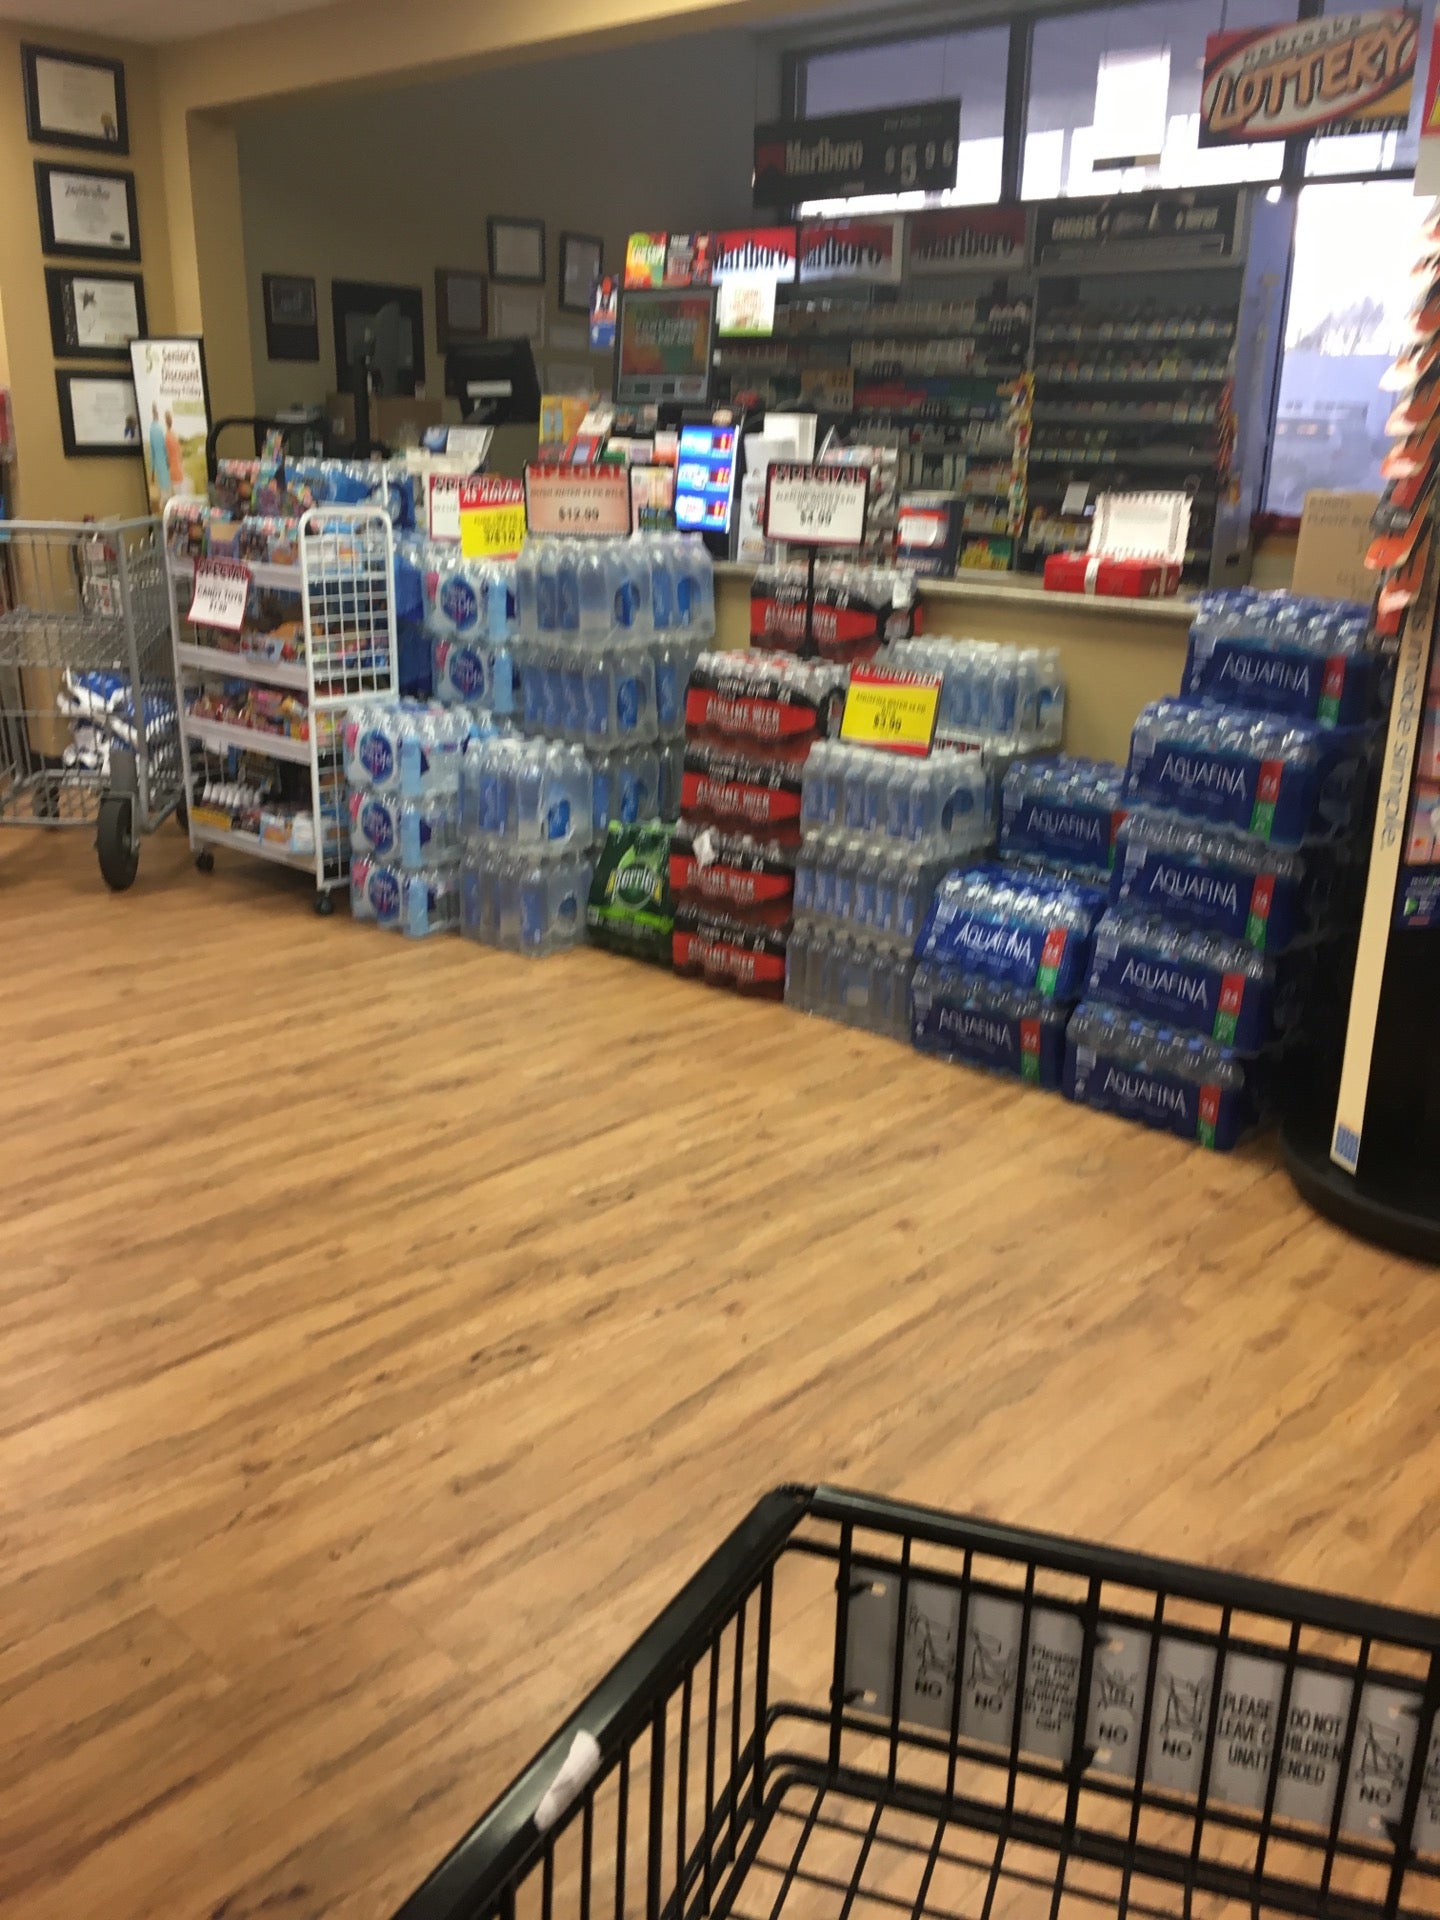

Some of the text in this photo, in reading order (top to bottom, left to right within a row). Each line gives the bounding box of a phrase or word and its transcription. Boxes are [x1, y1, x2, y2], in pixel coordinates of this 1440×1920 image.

[1208, 16, 1414, 133] LOTTERY
[775, 463, 860, 485] SPECIAL
[872, 664, 941, 688] ADVERTISED
[1219, 651, 1310, 697] AQUAFINA
[1159, 752, 1248, 800] AQUAFINA
[1026, 805, 1101, 845] AQUAFINA
[1149, 864, 1238, 915] AQUAFINA
[953, 918, 1032, 965] AQUAFINA
[1120, 957, 1209, 1010] AQUAFINA
[938, 1007, 1013, 1052] AQUAFINA
[1104, 1066, 1187, 1119] AQUAFINA
[914, 1679, 943, 1698] NO
[974, 1691, 1003, 1714] NO
[1099, 1722, 1129, 1746] NO
[1222, 1690, 1342, 1737] PLEASE DO NOT
[1162, 1739, 1192, 1761] NO
[1359, 1785, 1392, 1808] NO
